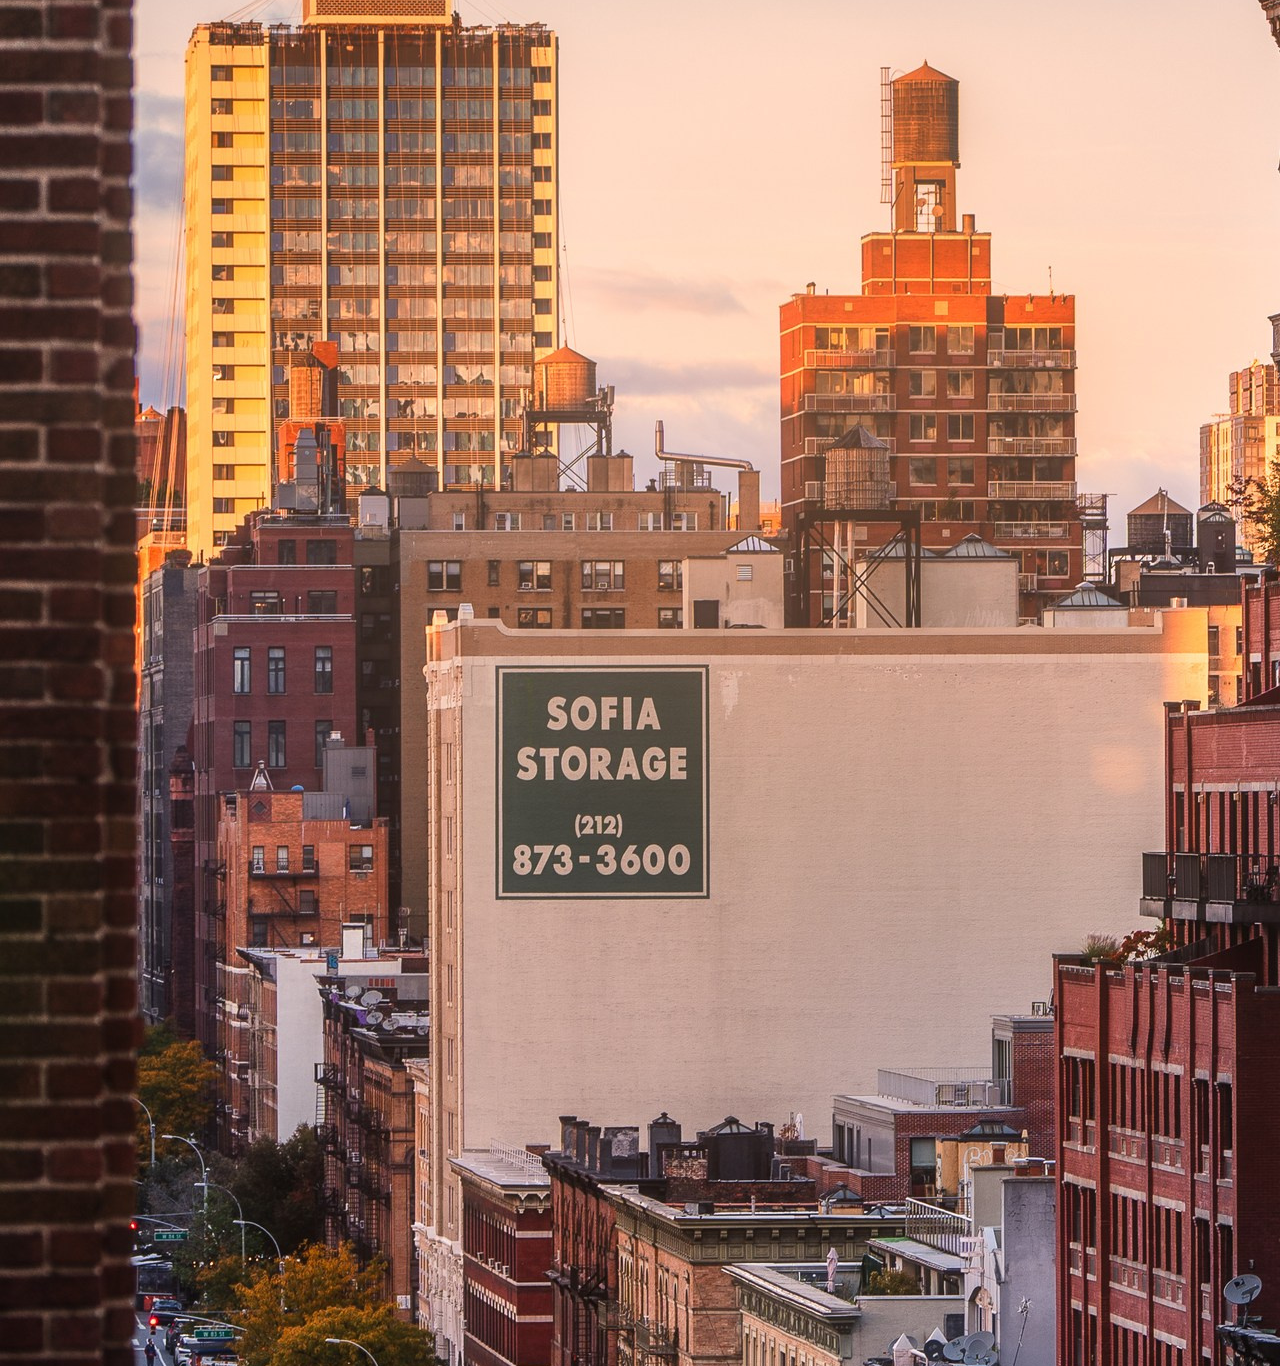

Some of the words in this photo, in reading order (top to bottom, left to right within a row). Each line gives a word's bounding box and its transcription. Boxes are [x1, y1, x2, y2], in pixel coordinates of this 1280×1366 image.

[546, 695, 661, 731] SOFIA
[516, 745, 688, 781] STORAGE
[574, 813, 623, 838] (212)
[512, 844, 691, 876] 873-3600
